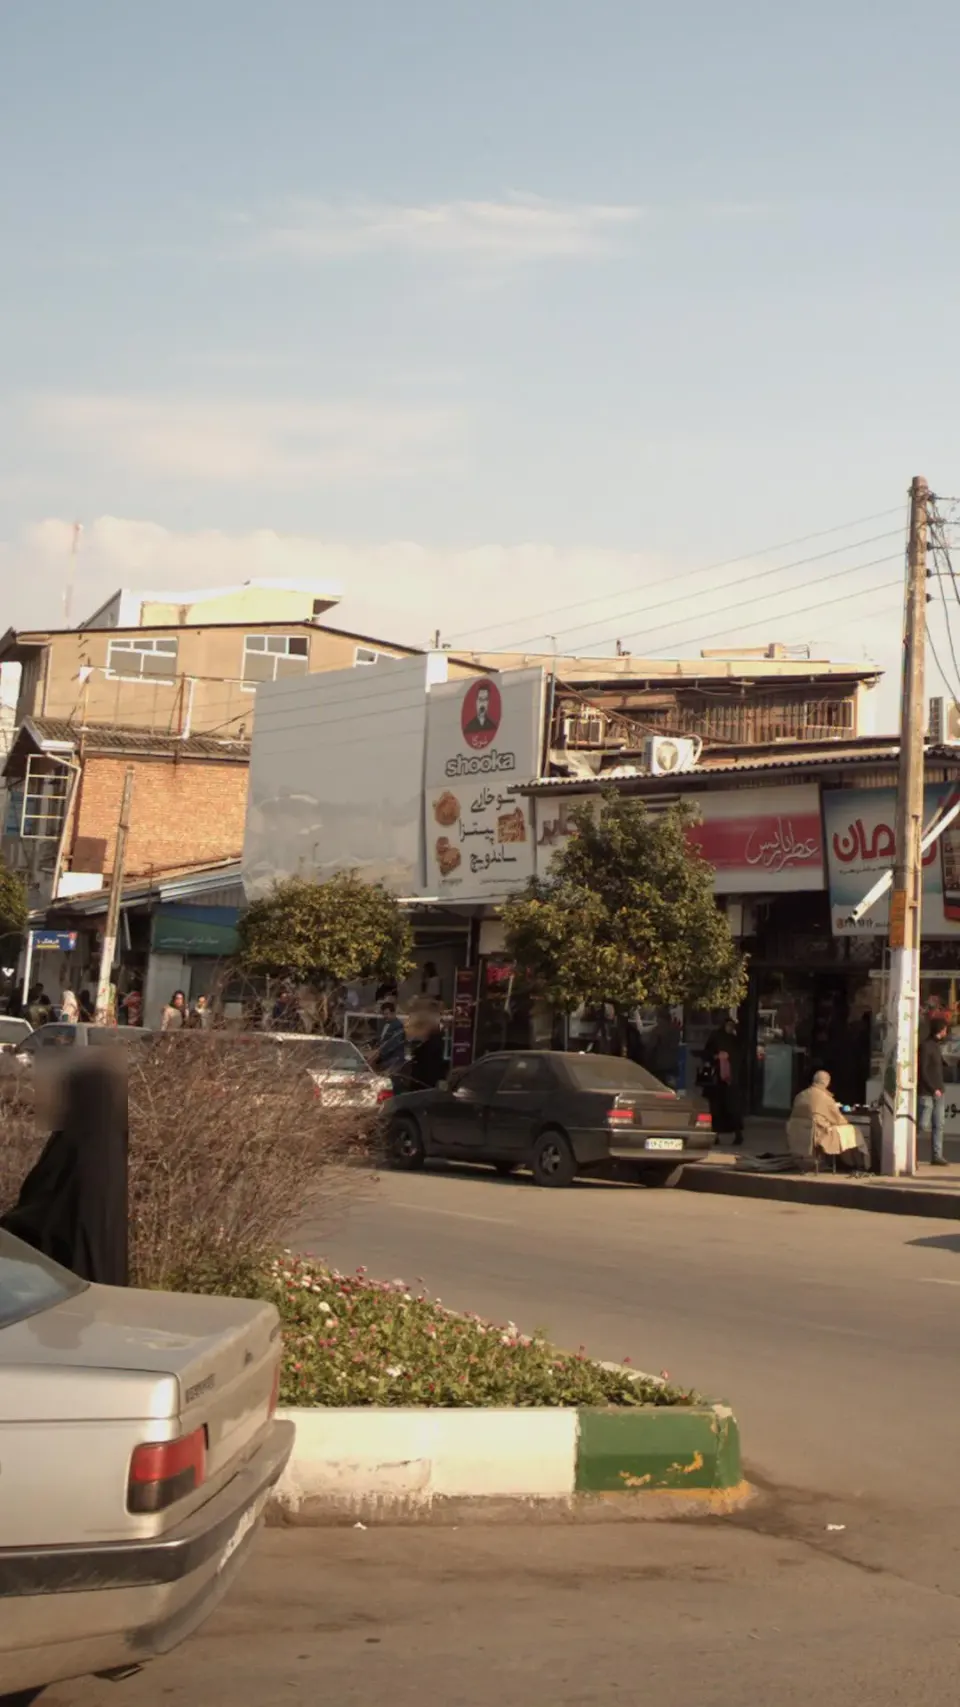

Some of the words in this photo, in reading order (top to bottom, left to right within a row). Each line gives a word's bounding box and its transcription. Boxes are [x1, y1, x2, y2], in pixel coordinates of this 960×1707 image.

[445, 749, 515, 777] shooka
[458, 817, 494, 845] پیتزا
[470, 844, 517, 873] ساندویچ
